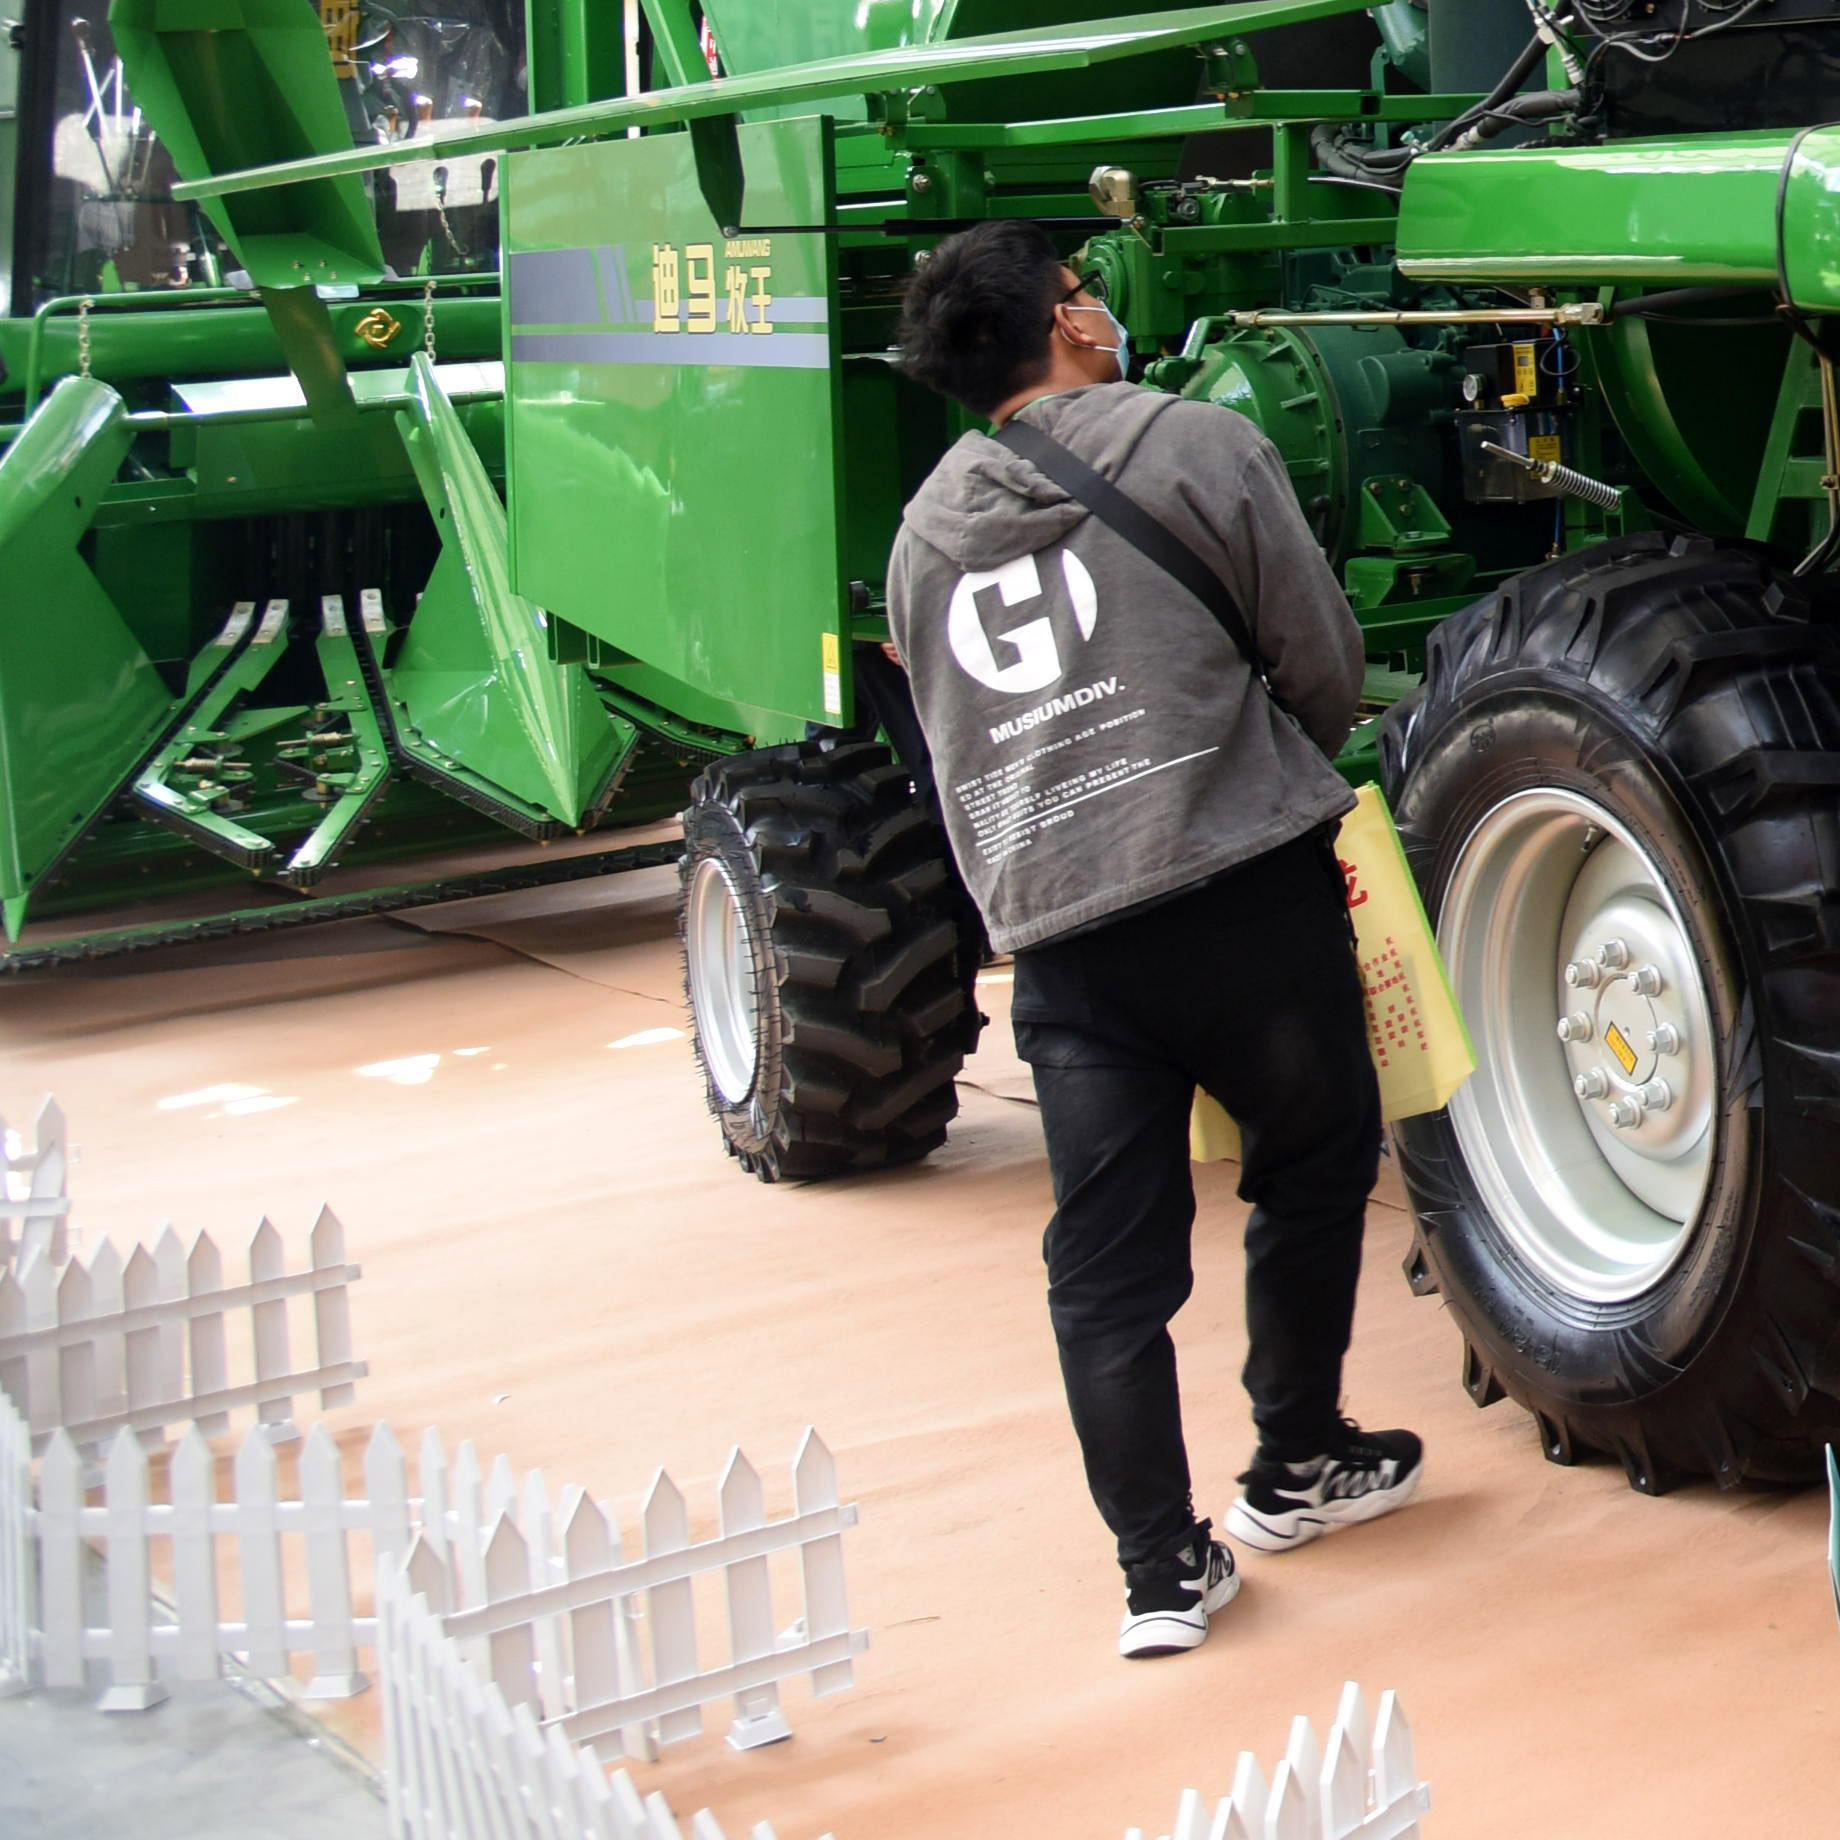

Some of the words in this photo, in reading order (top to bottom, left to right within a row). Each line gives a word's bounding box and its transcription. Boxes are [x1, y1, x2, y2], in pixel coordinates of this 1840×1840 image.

[652, 242, 718, 334] 迪马
[988, 676, 1127, 745] MUSIUMDIV.
[1074, 728, 1097, 742] AGE
